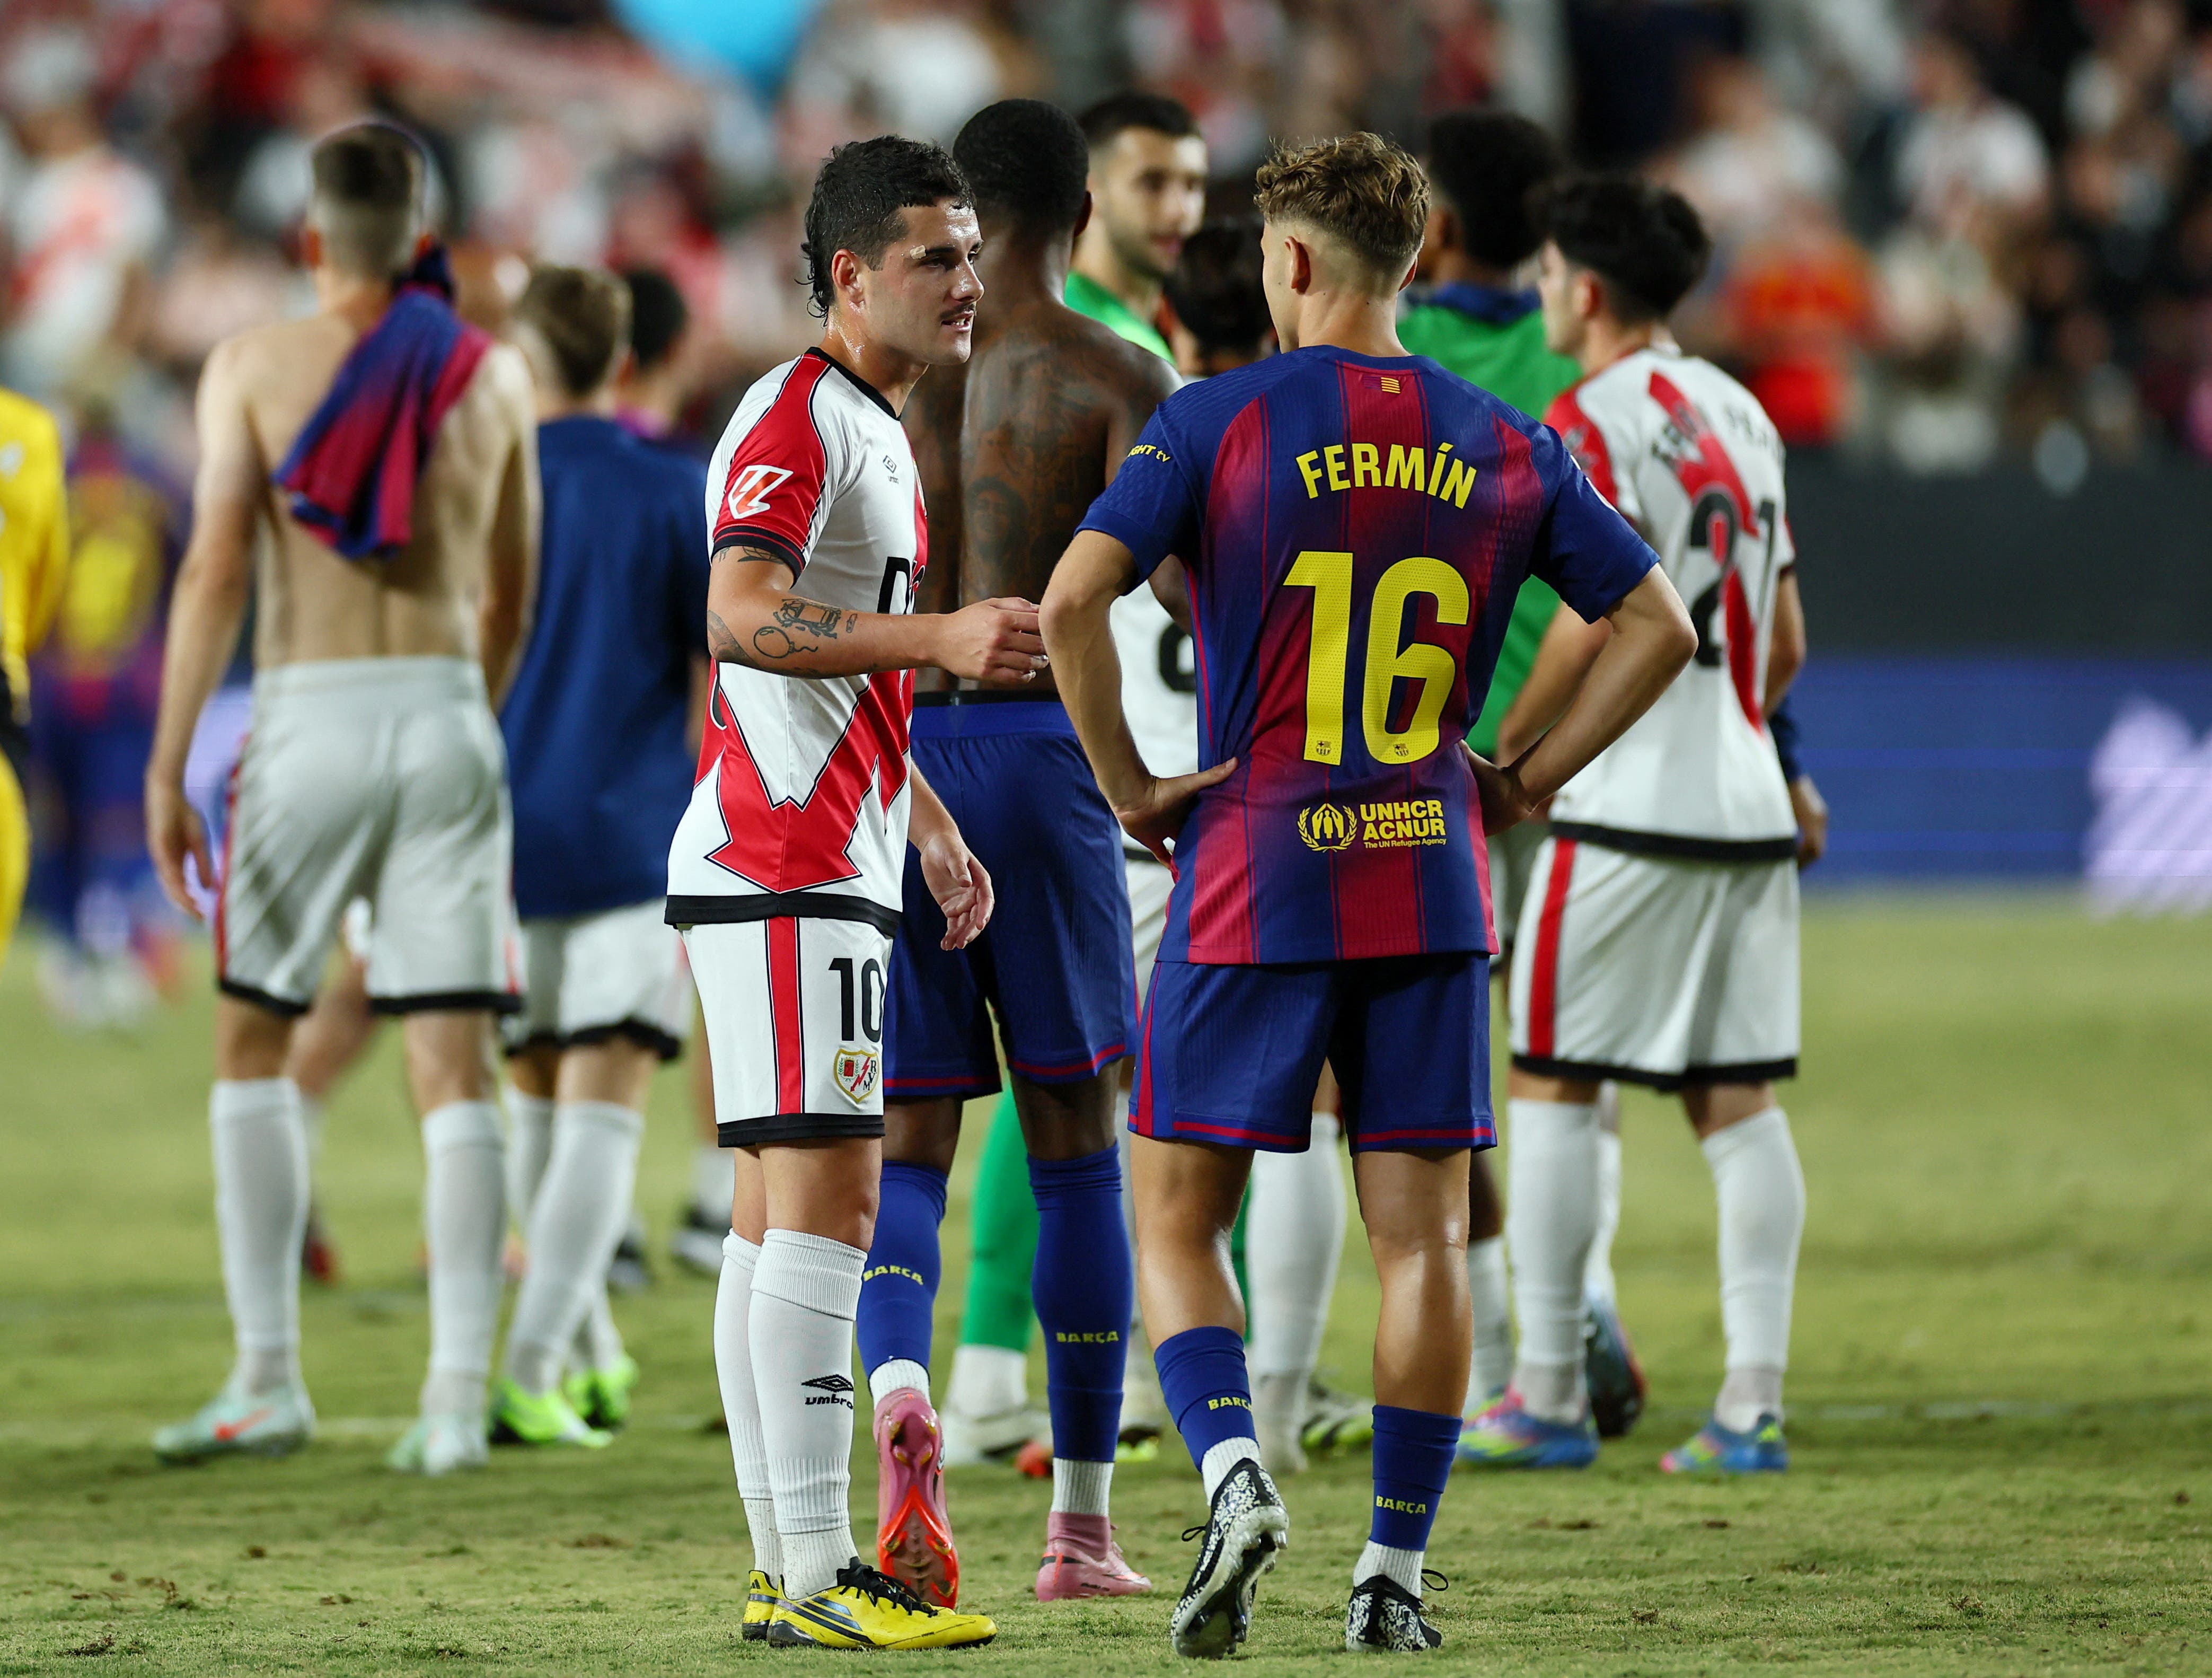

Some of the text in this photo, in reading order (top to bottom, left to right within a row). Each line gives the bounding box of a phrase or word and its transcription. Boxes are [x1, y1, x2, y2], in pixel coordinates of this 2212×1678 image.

[1156, 450, 1170, 462] tv
[1296, 442, 1477, 509] FERMÍN
[1283, 551, 1469, 766] 16
[1360, 800, 1443, 821] UNHCR
[1363, 818, 1446, 840] ACNUR
[828, 957, 885, 1043] 10
[805, 1394, 853, 1410] umbro
